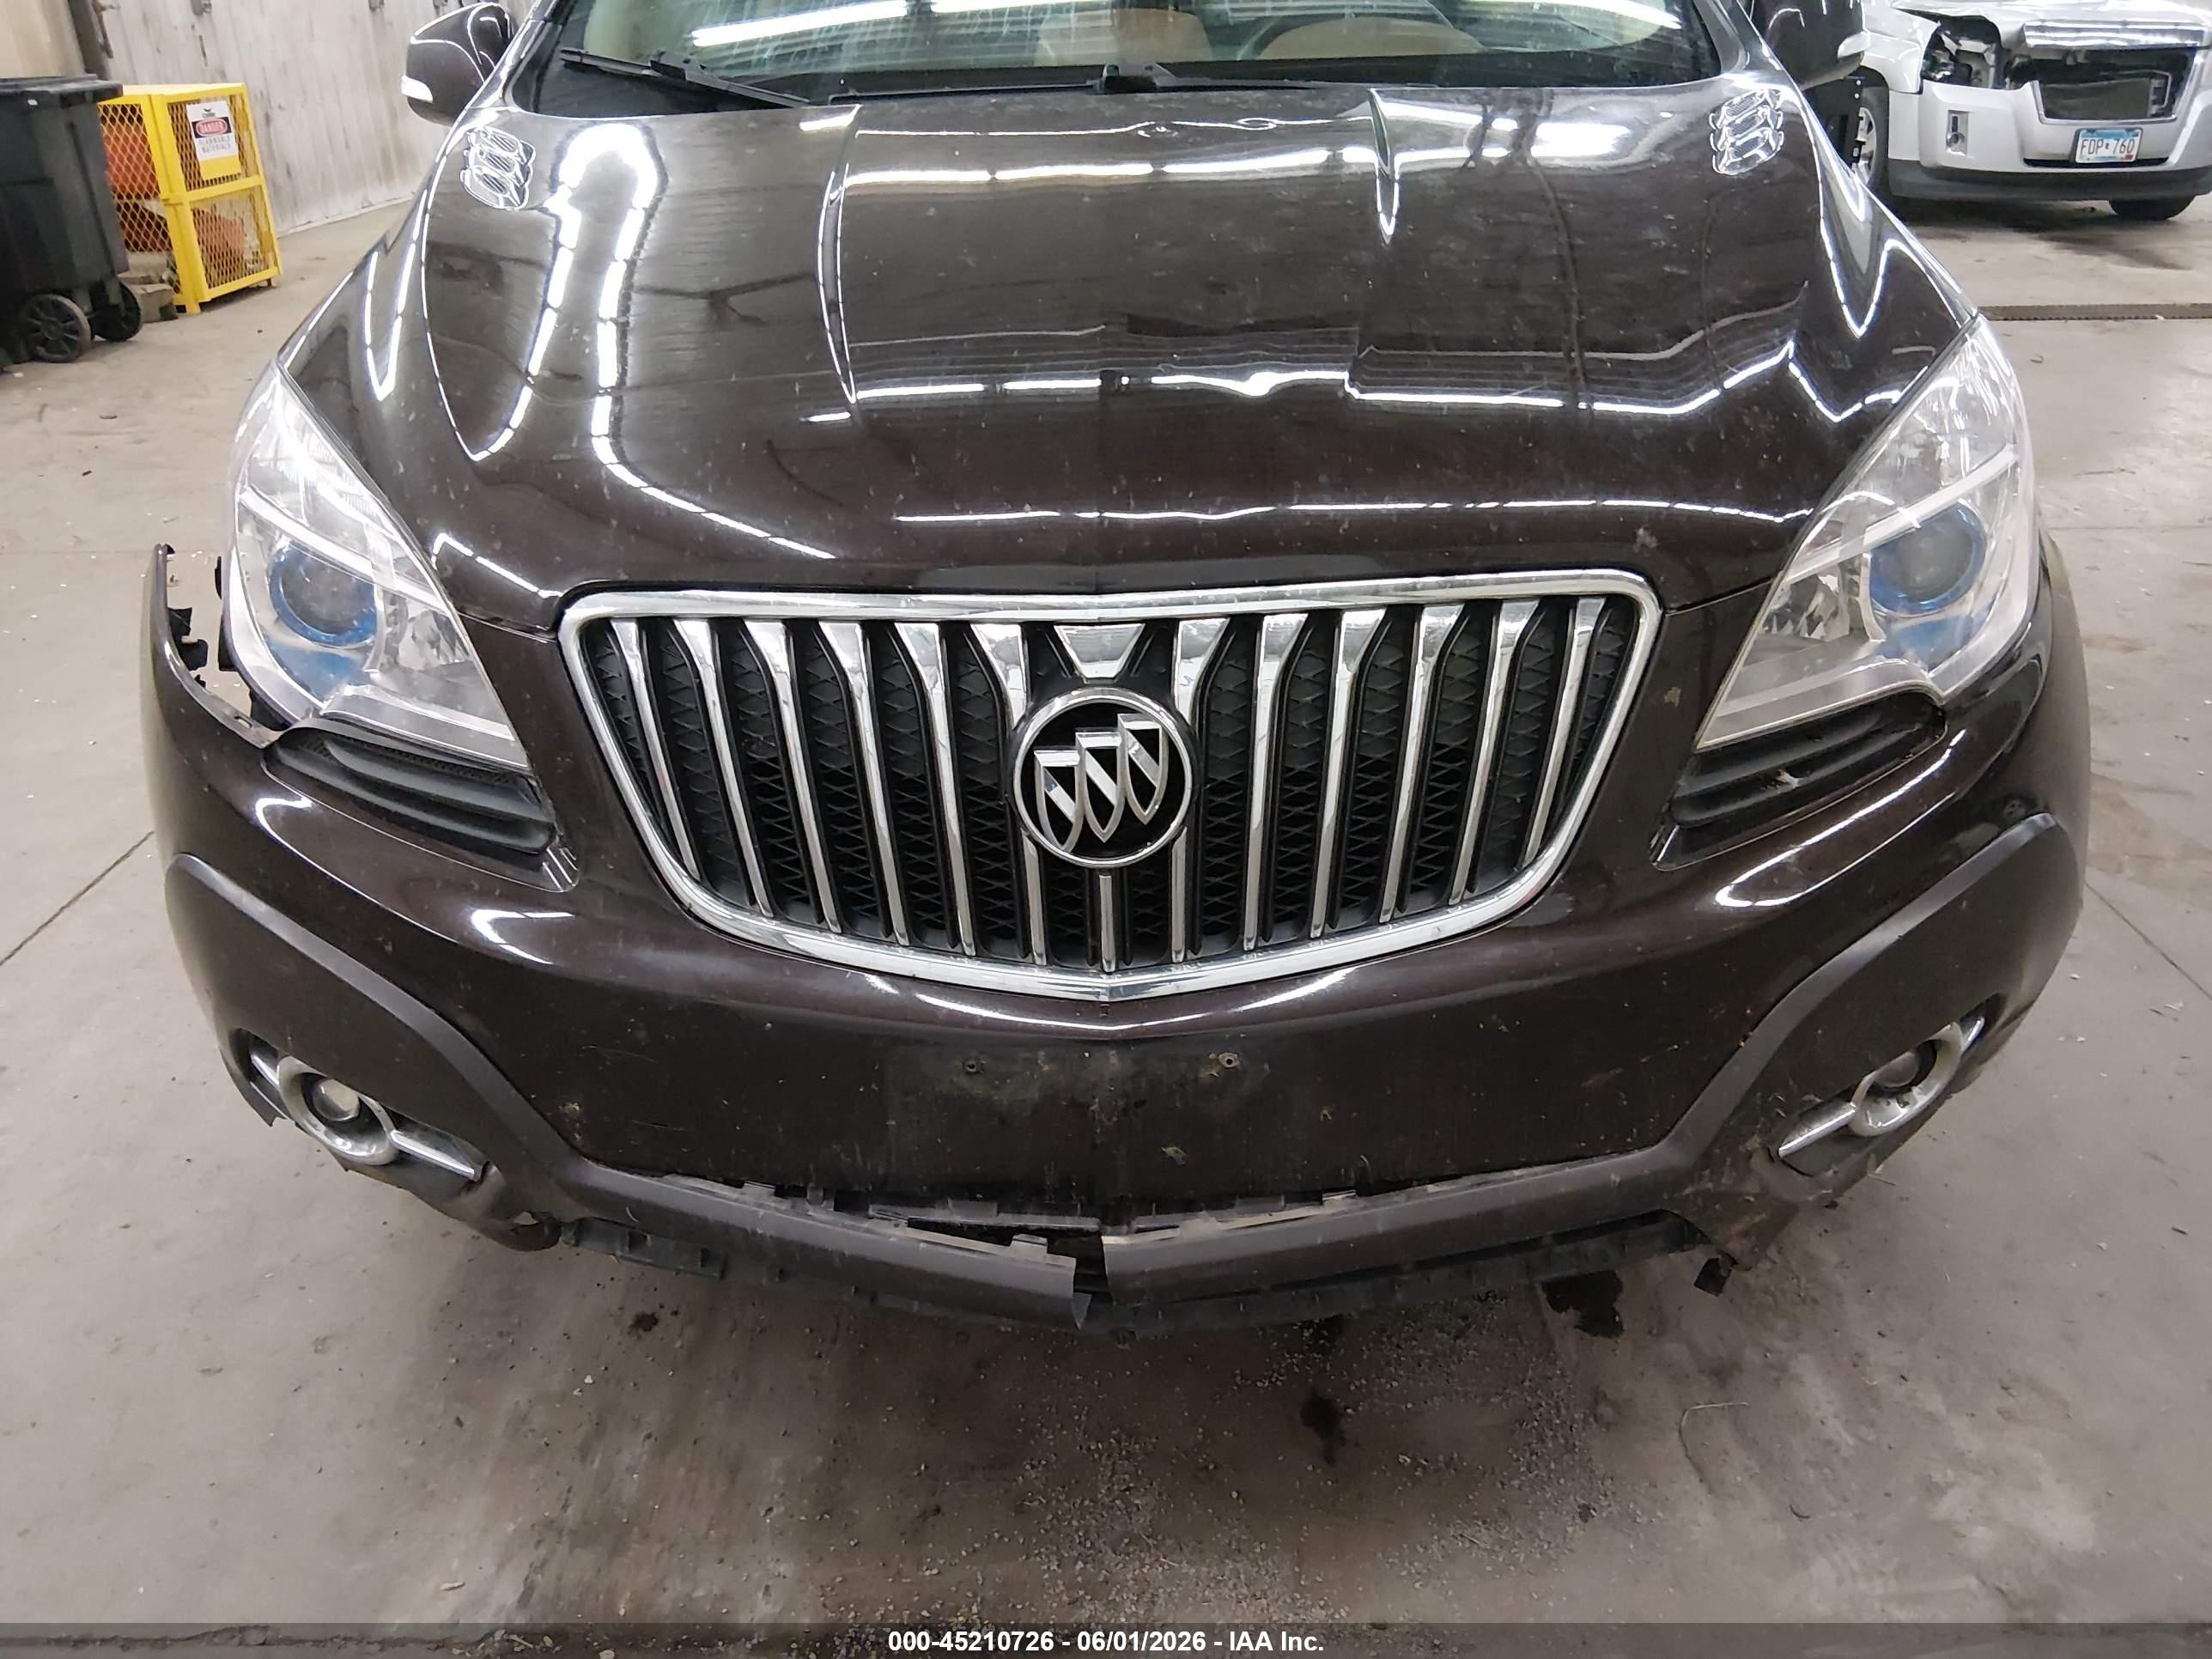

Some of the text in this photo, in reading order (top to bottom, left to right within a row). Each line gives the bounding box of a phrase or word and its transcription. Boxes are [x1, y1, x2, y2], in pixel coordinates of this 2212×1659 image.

[198, 120, 225, 133] DANGER
[2081, 137, 2136, 155] FDP 760
